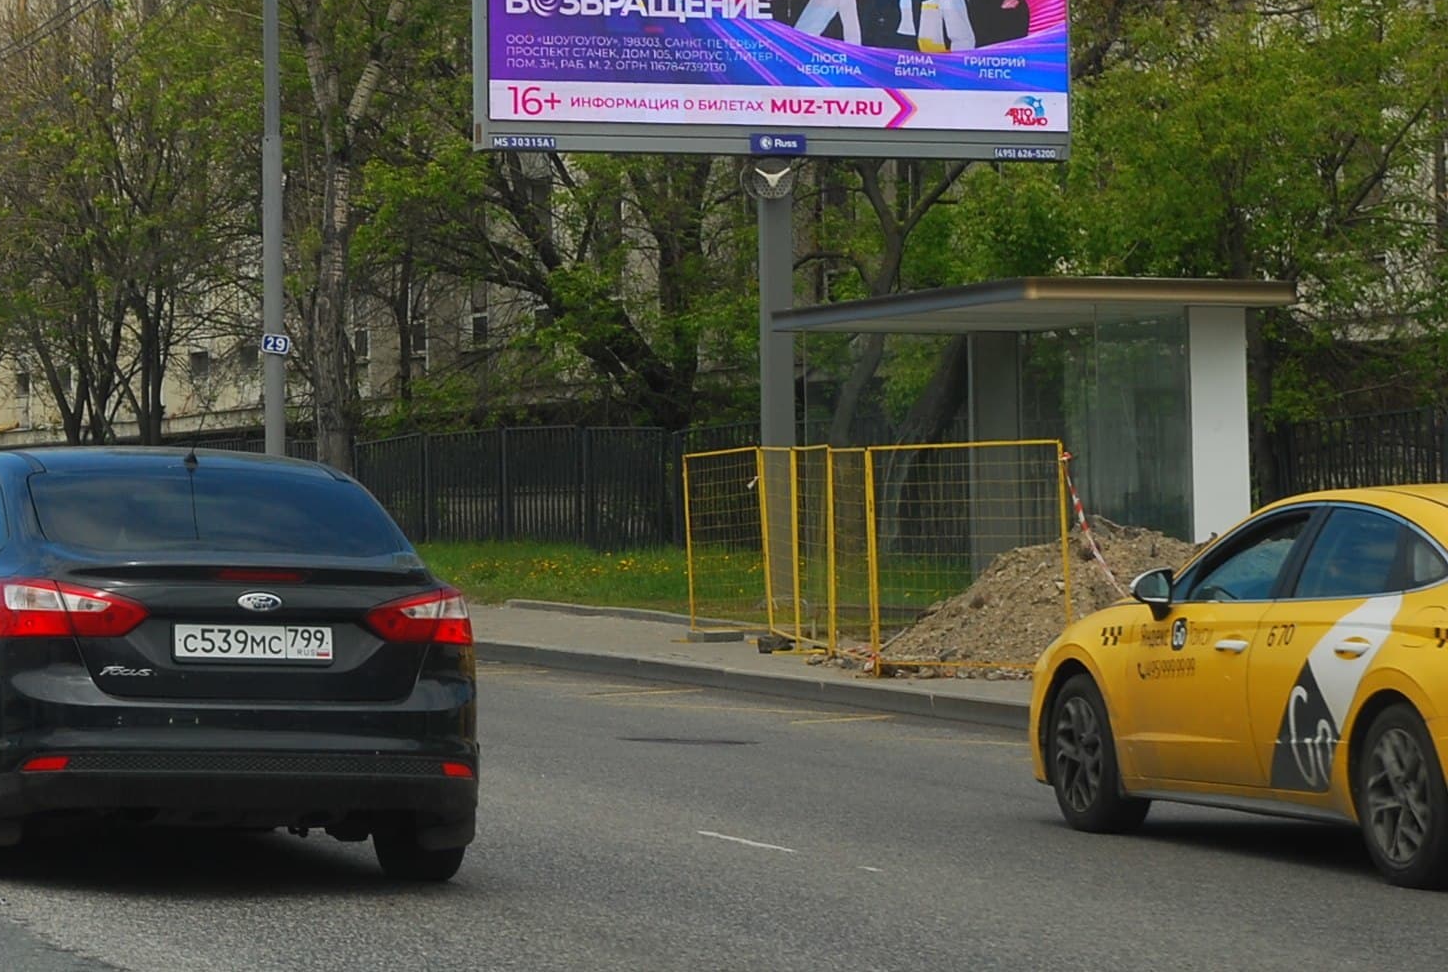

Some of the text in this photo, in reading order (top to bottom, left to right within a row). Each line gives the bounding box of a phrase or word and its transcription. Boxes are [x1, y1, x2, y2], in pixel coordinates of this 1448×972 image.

[506, 34, 534, 45] ООО
[506, 46, 569, 58] ПРОСПЕКТ
[572, 47, 619, 59] СТАЧЕК,
[621, 48, 650, 59] ДОМ
[675, 50, 723, 61] КОРПУС
[811, 53, 847, 64] ЛЮСЯ
[615, 60, 647, 71] ОГРН
[897, 54, 934, 66] ДИМА
[963, 55, 1026, 68] ГРИГОРИЙ
[797, 64, 861, 75] ЧЕБОТИНА
[895, 66, 936, 77] БИЛАН
[978, 68, 1012, 79] ЛЕПС
[508, 86, 883, 116] 16+ ИНФОРМАЦИЯ О БИЛЕТАХ MUZ-TV.RU
[494, 137, 508, 147] MS
[774, 138, 798, 149] Russ
[266, 336, 286, 351] 29
[183, 628, 325, 655] С539МС 799
[297, 649, 316, 657] RUS
